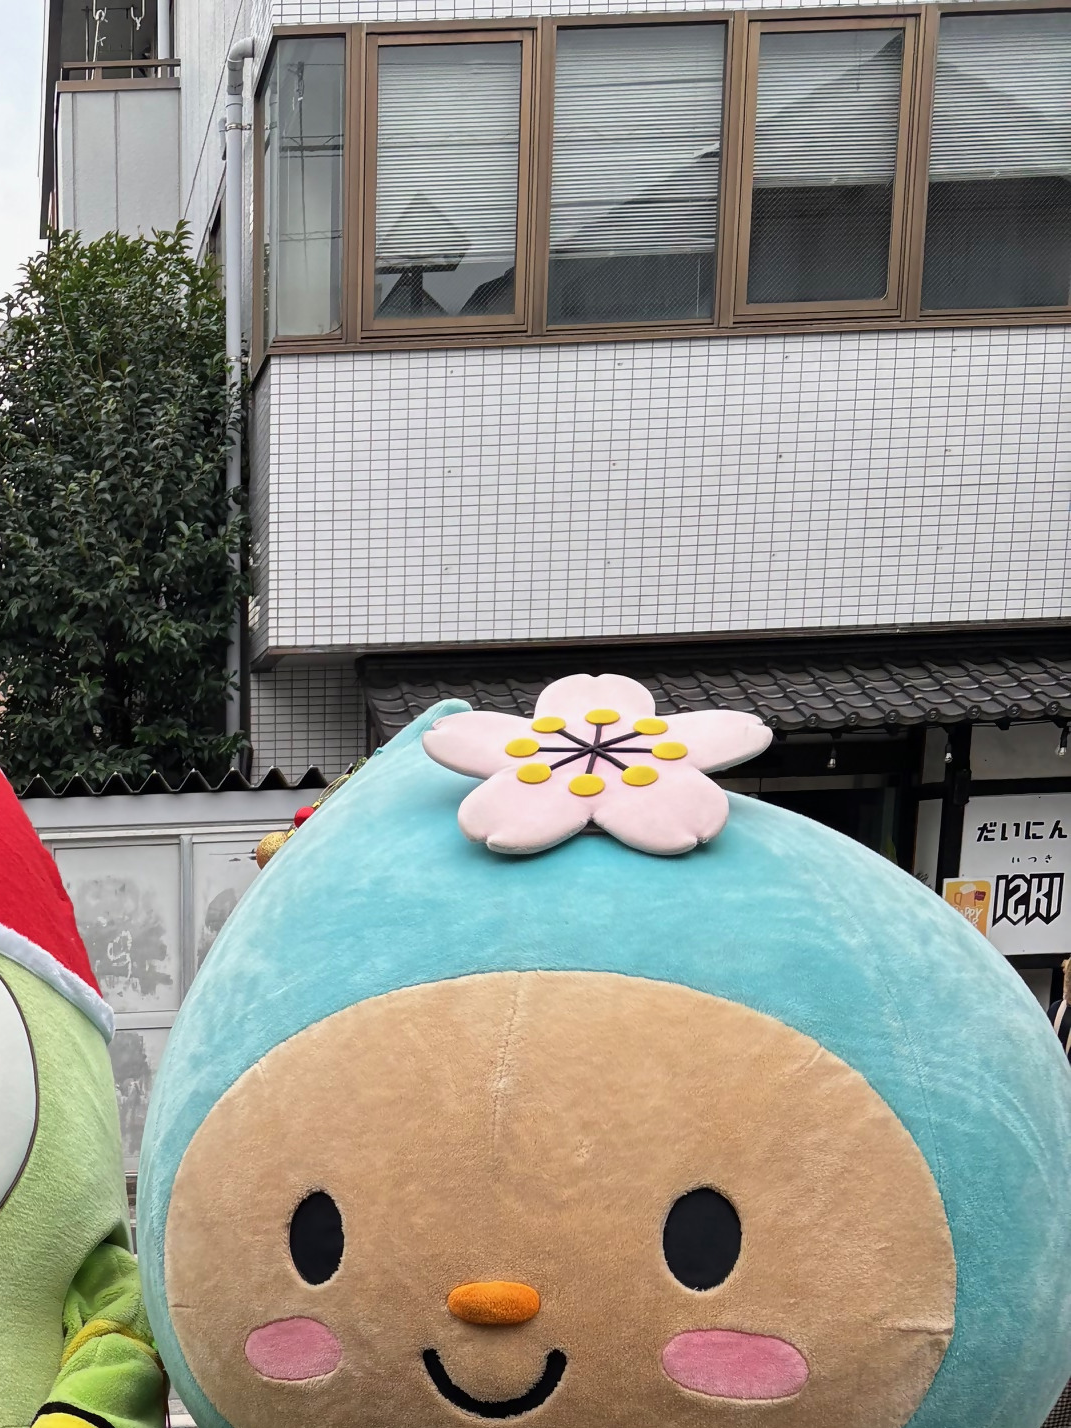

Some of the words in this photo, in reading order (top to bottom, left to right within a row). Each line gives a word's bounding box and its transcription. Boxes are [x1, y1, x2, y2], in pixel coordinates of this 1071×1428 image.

[976, 820, 1068, 842] だいにん
[1011, 854, 1052, 864] いつき
